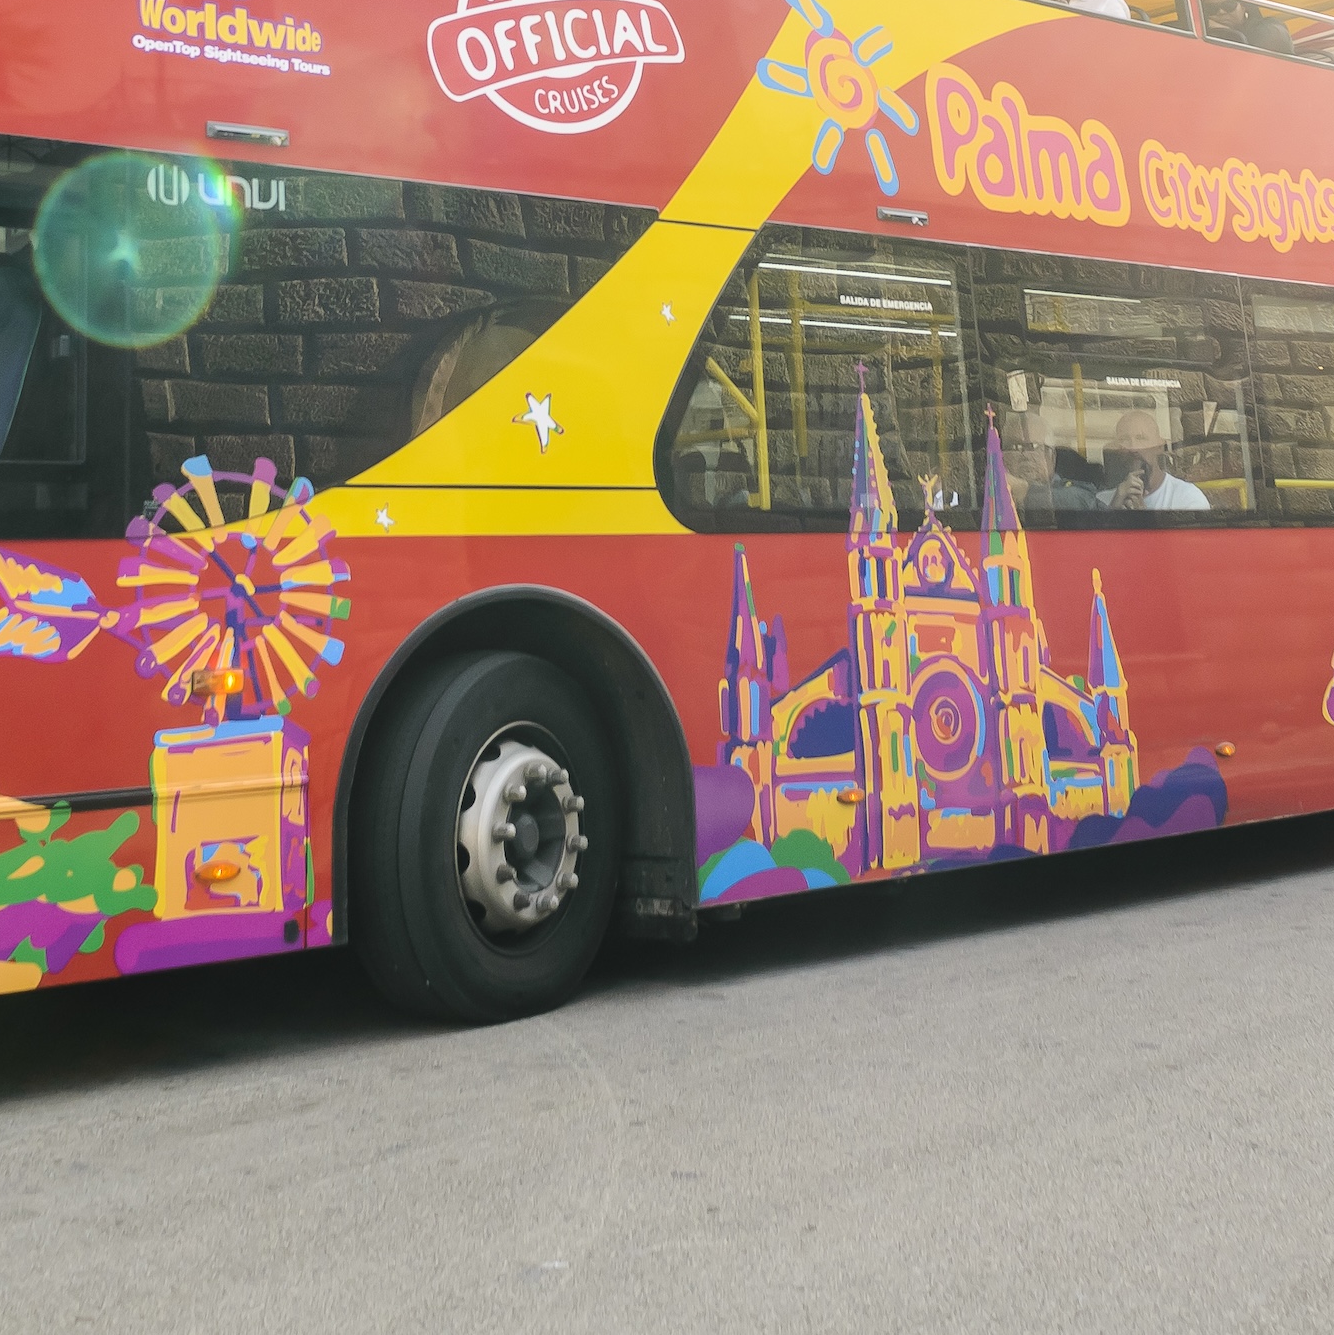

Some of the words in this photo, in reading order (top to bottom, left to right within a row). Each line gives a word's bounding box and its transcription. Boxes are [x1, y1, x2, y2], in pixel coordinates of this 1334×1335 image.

[203, 44, 290, 72] Sightseeing
[290, 57, 332, 76] Tours
[456, 8, 668, 82] OFFICIAL
[533, 75, 619, 115] CRUISES
[928, 65, 1129, 224] Palma
[839, 294, 870, 307] SALIDA
[870, 298, 882, 308] DE
[881, 298, 934, 312] EMERGENCIA
